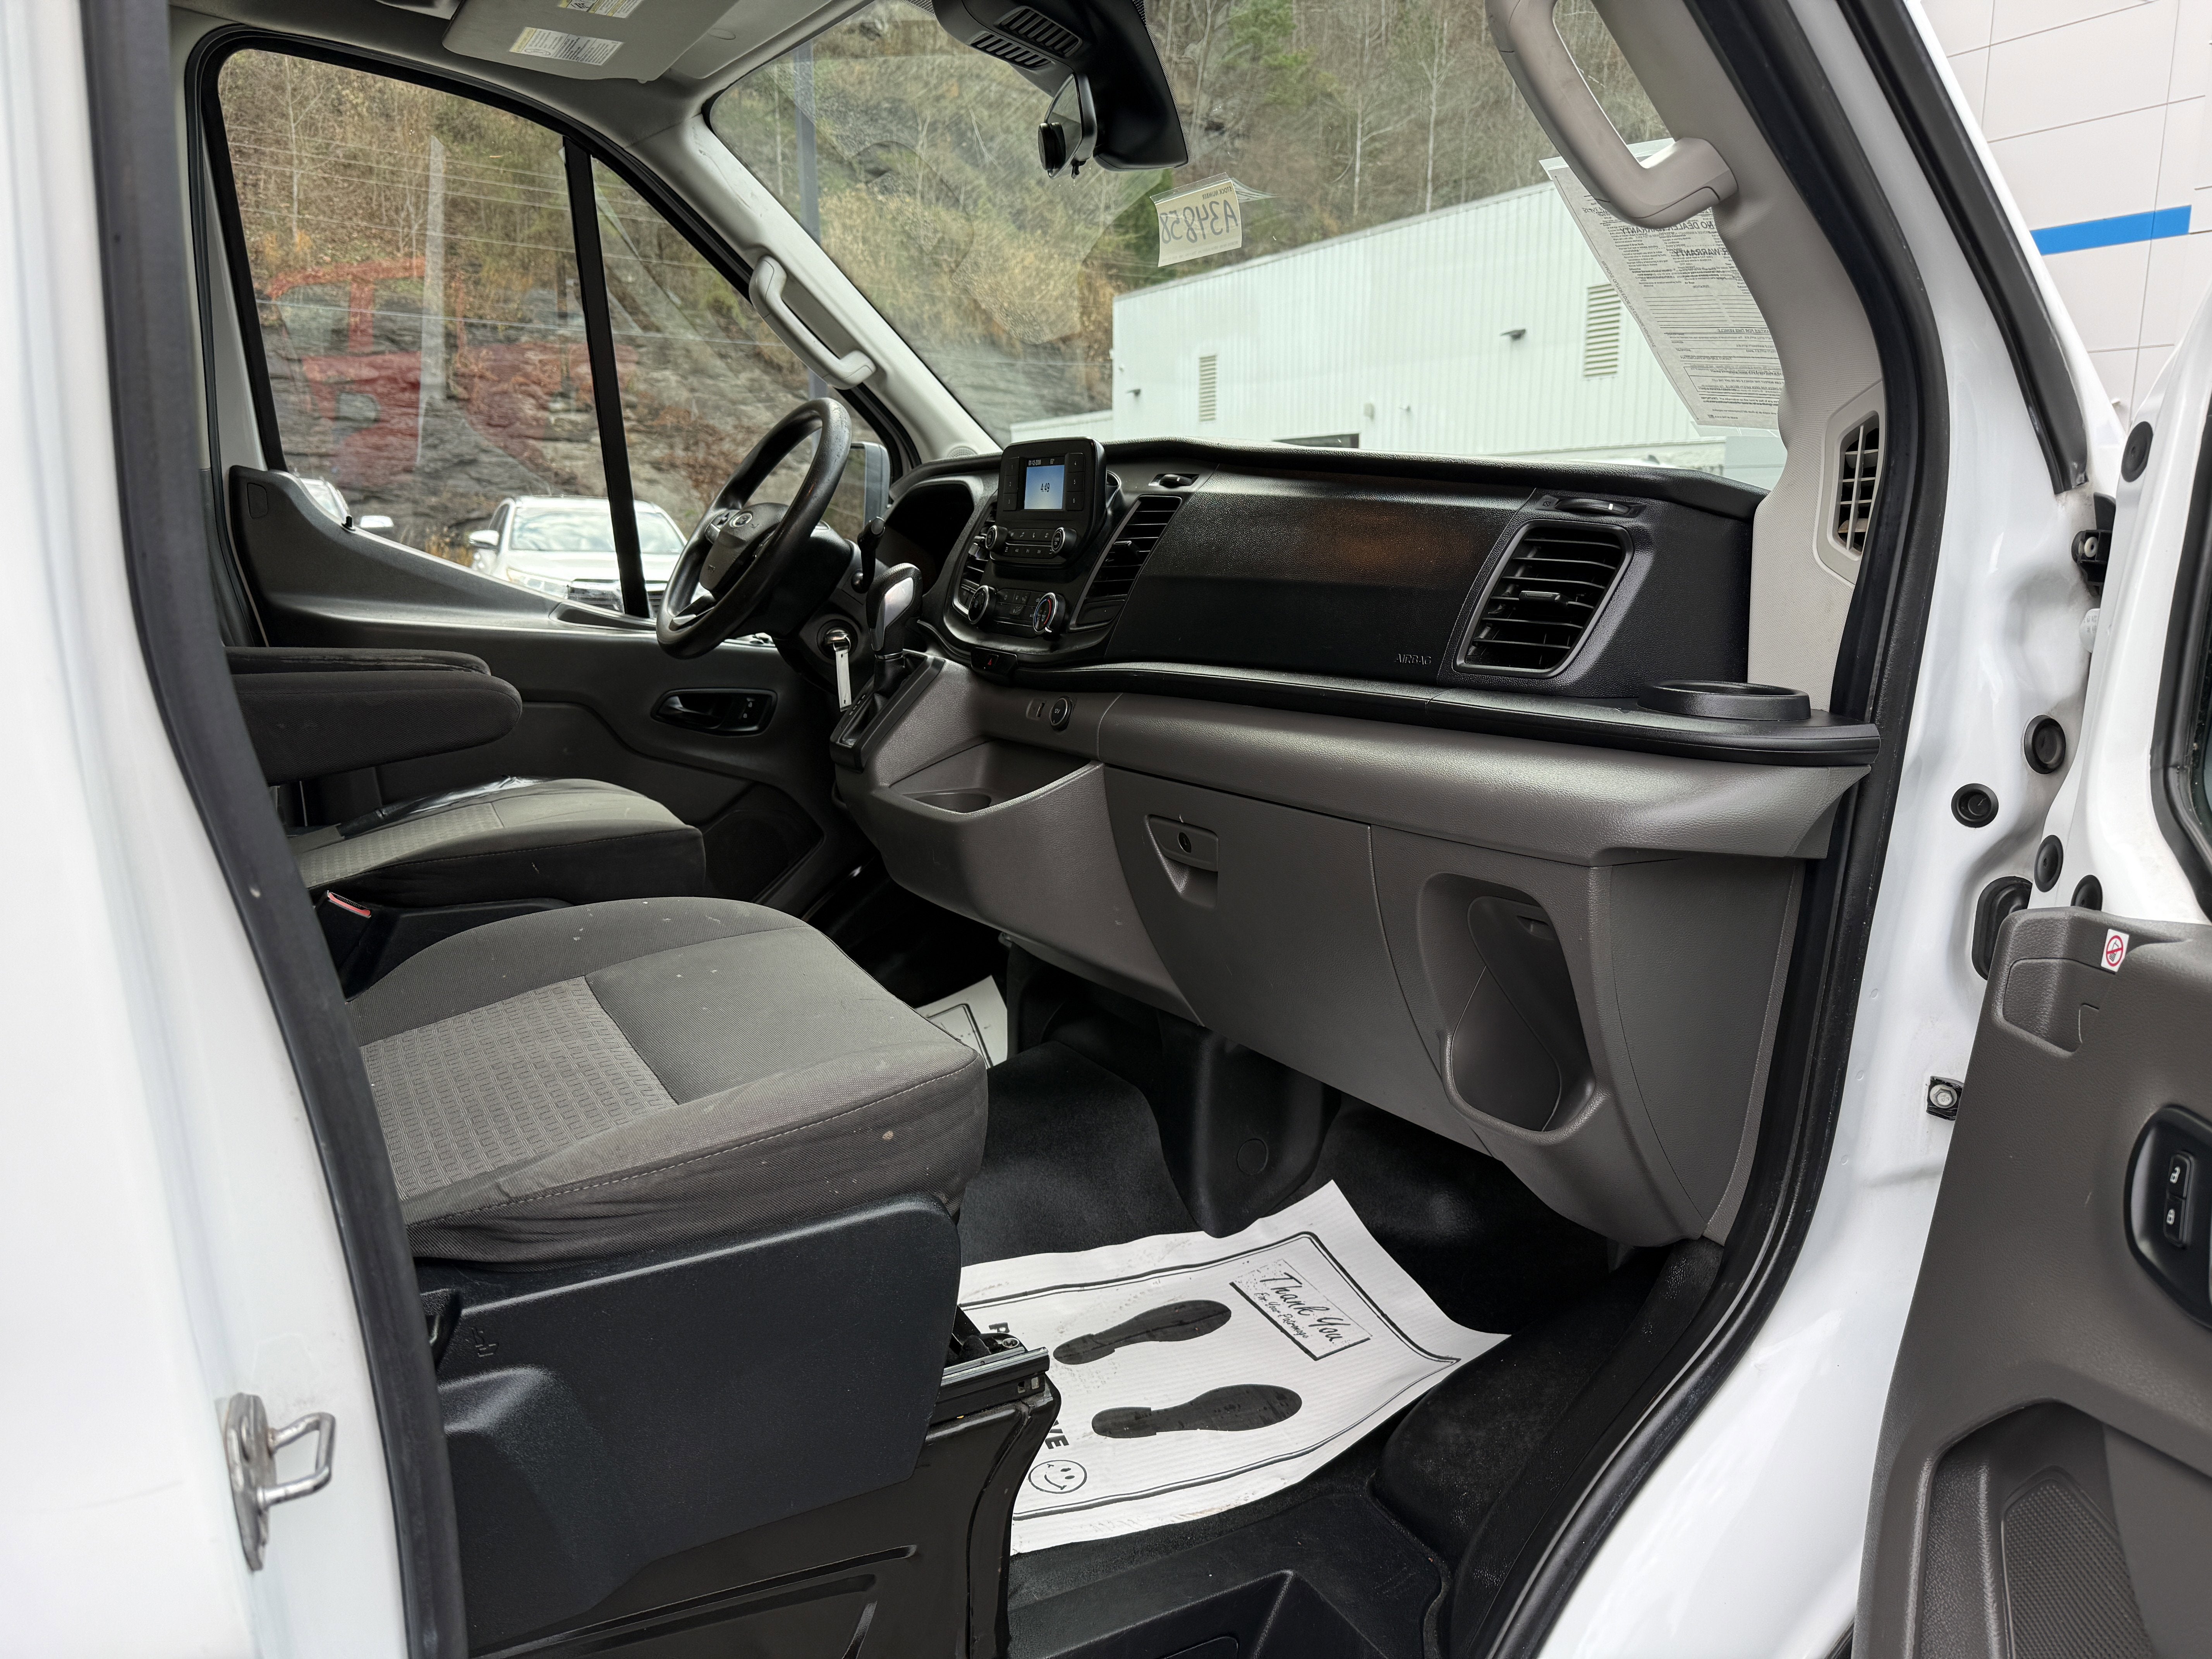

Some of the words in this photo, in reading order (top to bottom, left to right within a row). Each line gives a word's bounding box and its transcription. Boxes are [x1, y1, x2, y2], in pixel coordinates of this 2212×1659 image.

[1040, 483, 1050, 493] 4:49
[1394, 653, 1431, 665] AIRBAG
[1259, 1272, 1330, 1316] Thank
[1254, 1292, 1270, 1302] For
[1264, 1302, 1281, 1314] Your
